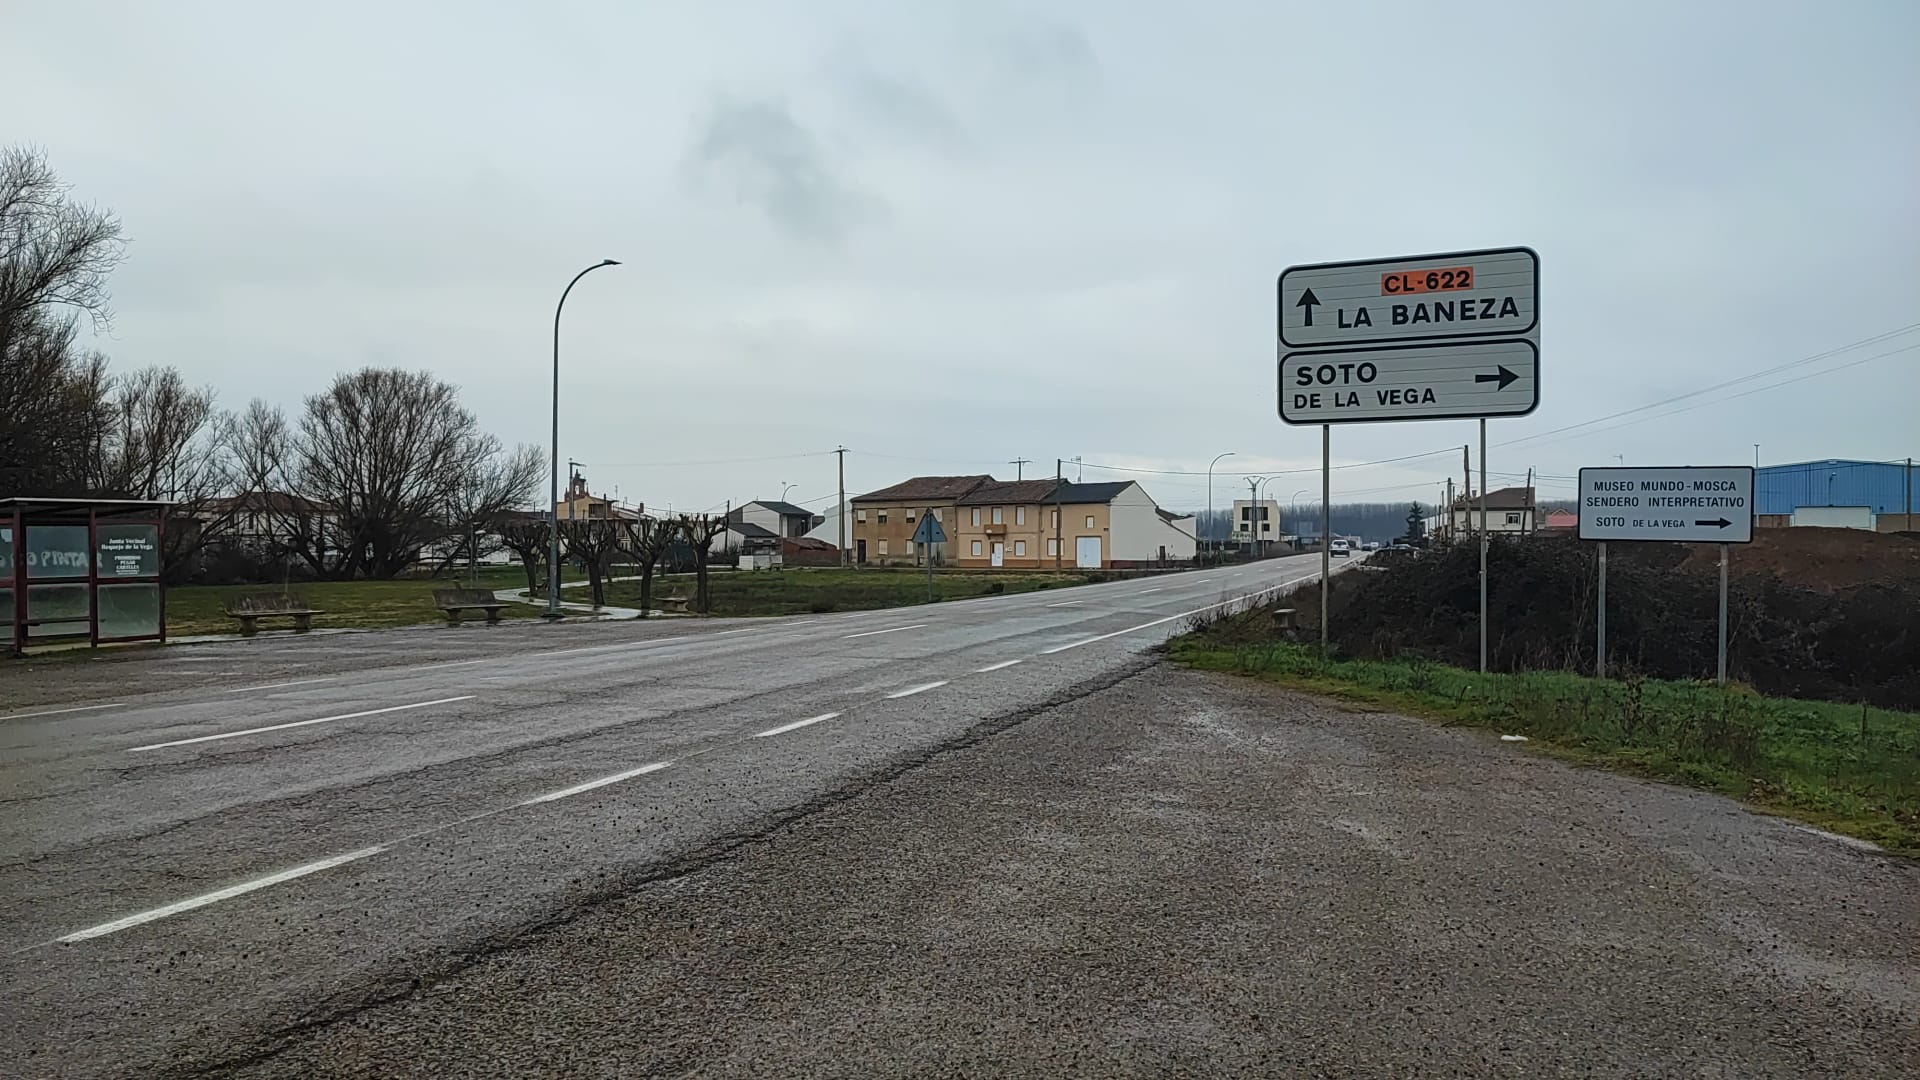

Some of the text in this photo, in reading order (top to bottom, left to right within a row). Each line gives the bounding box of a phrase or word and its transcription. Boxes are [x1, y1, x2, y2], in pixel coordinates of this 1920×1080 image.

[1384, 270, 1471, 293] CL-622
[1337, 296, 1520, 329] LA BANEZA
[1295, 361, 1378, 386] SOTO
[1294, 388, 1436, 409] DE LA VEGA
[1594, 481, 1634, 492] MUSEO
[1586, 497, 1744, 508] SENDERO INTERPRETATIVO
[1596, 517, 1685, 528] SOTO DE LA VEGA
